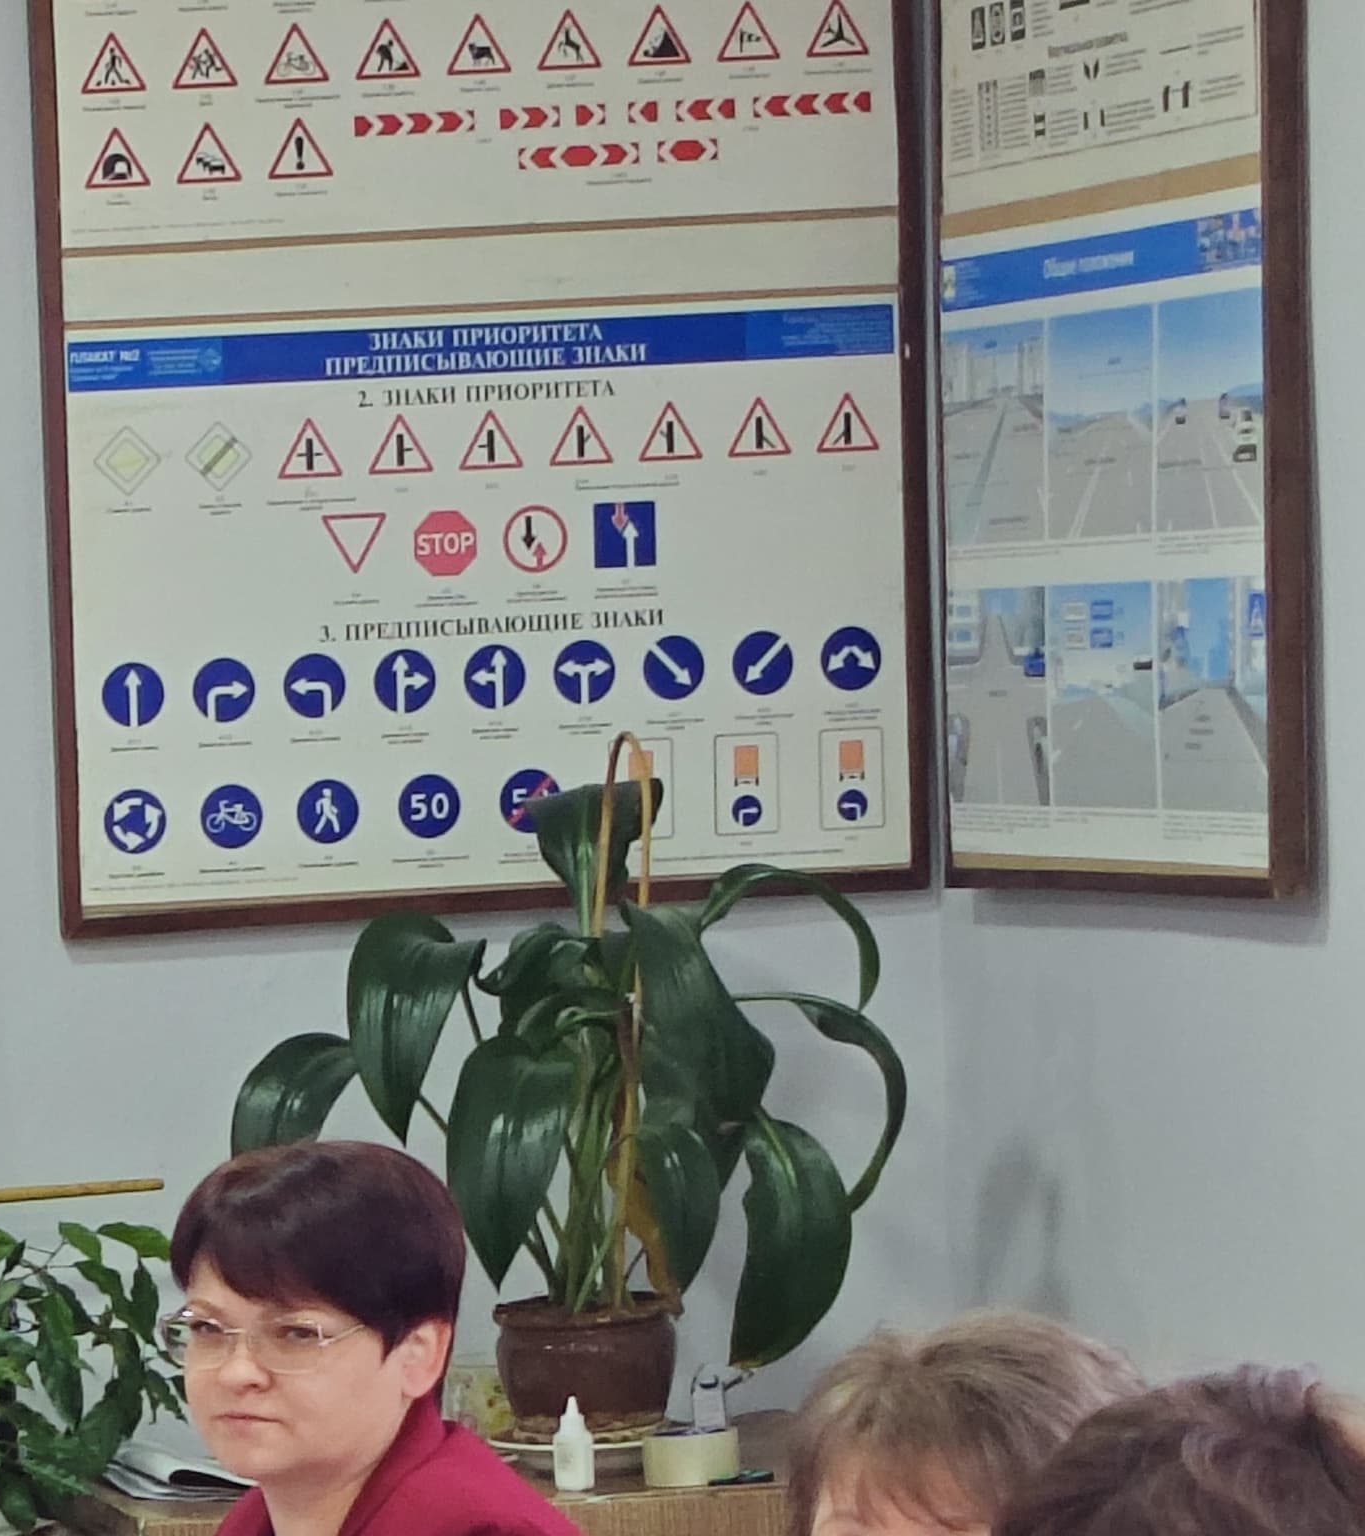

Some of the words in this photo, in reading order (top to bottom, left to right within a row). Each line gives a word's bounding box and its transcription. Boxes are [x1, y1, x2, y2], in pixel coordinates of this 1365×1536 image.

[369, 329, 444, 351] ЗНАКИ
[453, 323, 603, 348] ПРИОРИТЕТА
[325, 348, 566, 377] ПРЕДПИСЫВАЮЩИЕ
[573, 344, 646, 365] ЗНАКИ
[358, 390, 374, 408] 2.
[382, 386, 456, 408] ЗНАКИ
[466, 380, 616, 404] ПРИОРИТЕТА
[417, 532, 475, 556] STOP
[319, 625, 336, 643] 3.
[345, 611, 583, 642] ПРЕДПИСЫВАЮЩИЕ
[591, 608, 664, 629] ЗНАКИ
[410, 793, 449, 821] 50
